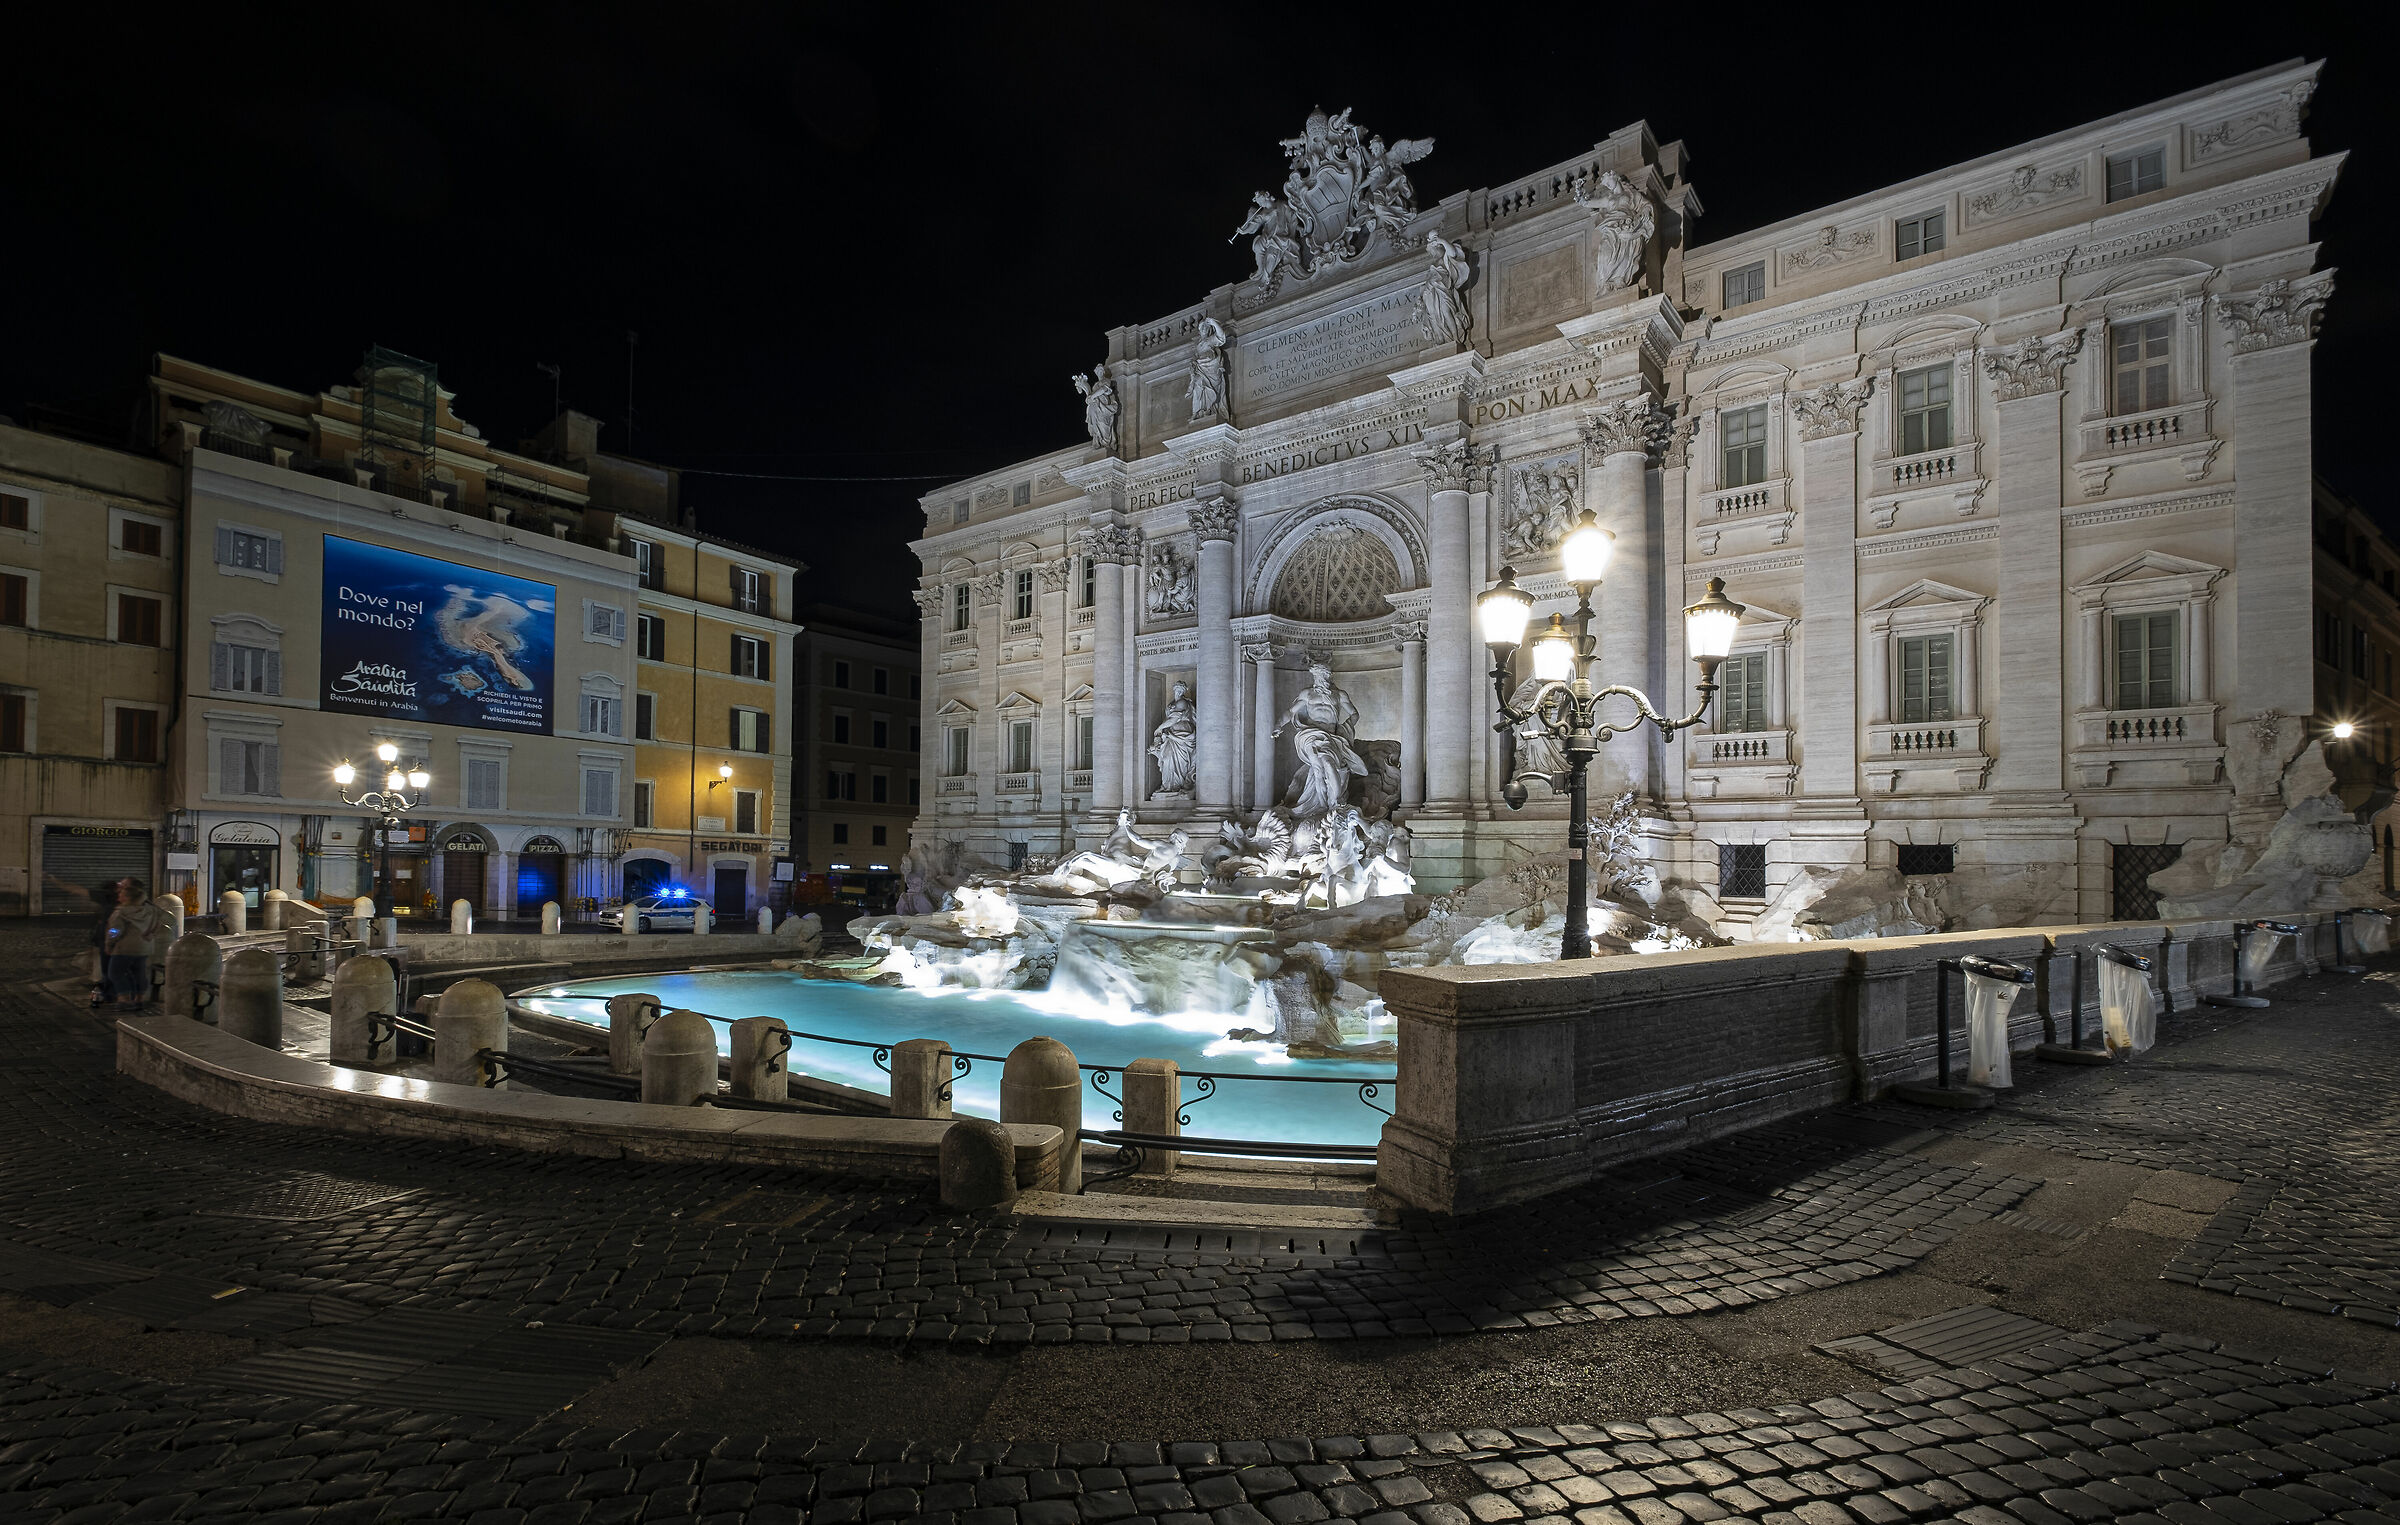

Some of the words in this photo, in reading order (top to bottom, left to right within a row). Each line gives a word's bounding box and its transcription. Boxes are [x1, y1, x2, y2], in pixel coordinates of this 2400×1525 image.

[1258, 330, 1308, 354] CLEMENS
[1290, 337, 1323, 354] AQVAM
[1328, 319, 1375, 341] VIRGINEM
[1248, 364, 1273, 378] COPIA
[1276, 359, 1285, 369] ET
[1288, 340, 1344, 366] SALVBRITATE
[1269, 366, 1297, 381] CVLTV
[1301, 349, 1352, 371] MAGNIFICO
[1356, 333, 1400, 354] ORNAVIT
[1251, 383, 1277, 398] ANNO
[1242, 436, 1369, 483] BENEDICTVS
[1386, 420, 1428, 448] XIV
[1539, 375, 1600, 410] MAX
[339, 586, 389, 608] Dove
[396, 600, 423, 615] nel
[338, 608, 415, 631] mondo?
[344, 660, 407, 681] Arabia
[331, 674, 418, 698] Saudita
[330, 693, 377, 706] Benvenuti
[379, 699, 388, 707] in
[390, 701, 419, 711] Arabia
[477, 696, 508, 706] SCOPRILA
[523, 702, 542, 710] PRIMO
[483, 690, 511, 699] RICHIEDI
[519, 695, 537, 703] VISTO
[481, 714, 542, 727] #welcometoarabia
[489, 707, 543, 719] visitsaudi.com
[71, 826, 129, 838] GIORGIO
[214, 832, 271, 845] Gelateria
[447, 842, 485, 852] GELATI
[529, 844, 561, 853] PIZZA
[701, 840, 764, 852] SEGATORI
